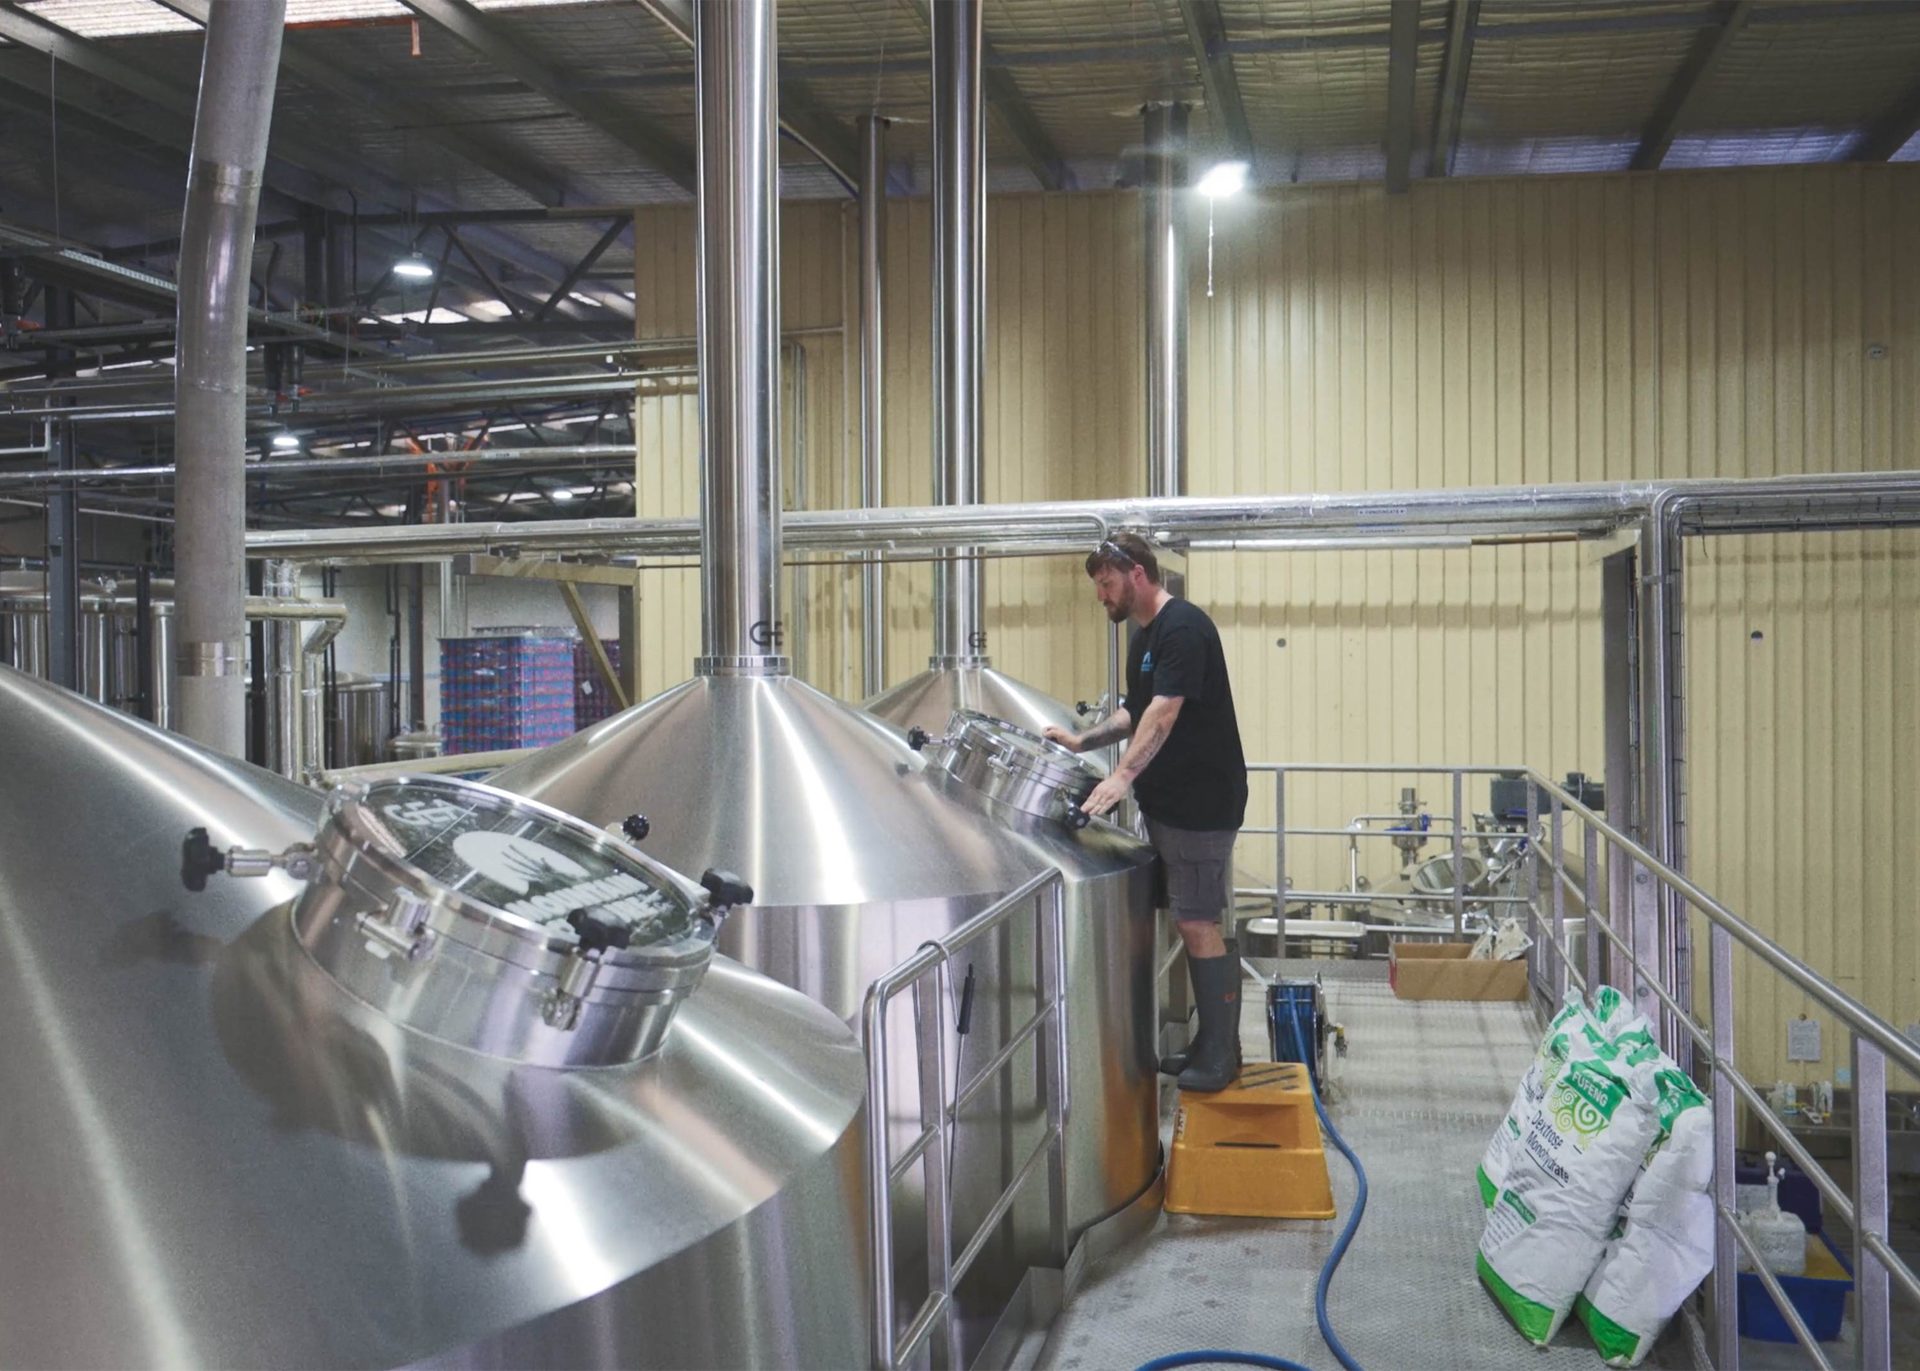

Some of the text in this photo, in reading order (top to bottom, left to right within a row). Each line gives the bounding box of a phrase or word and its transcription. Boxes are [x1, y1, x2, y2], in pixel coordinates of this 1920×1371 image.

[1571, 1070, 1609, 1108] FUFENG
[1531, 1109, 1564, 1150] Dextrose
[1525, 1130, 1570, 1184] Monohydrate
